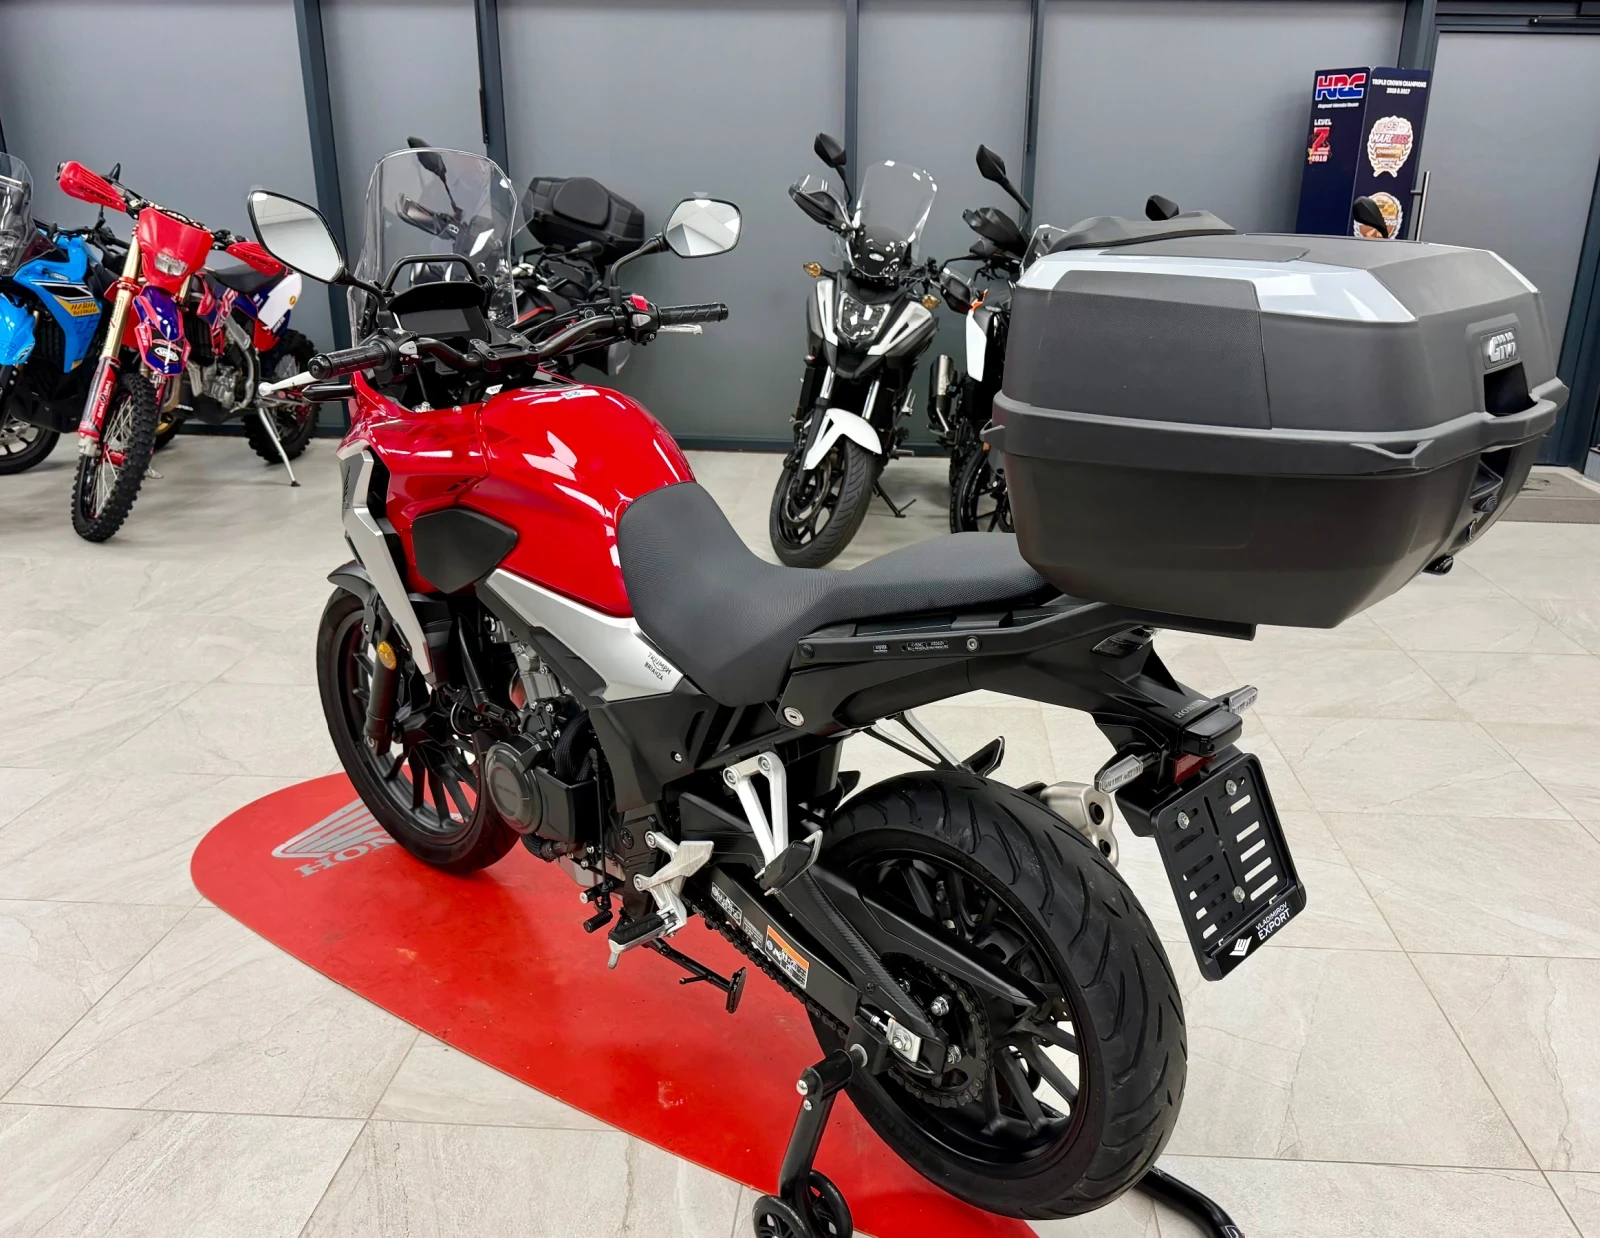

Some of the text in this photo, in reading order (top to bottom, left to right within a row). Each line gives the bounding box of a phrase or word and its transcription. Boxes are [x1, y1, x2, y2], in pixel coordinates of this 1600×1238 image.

[1315, 73, 1366, 100] HRC
[644, 661, 664, 681] BRIANZA
[647, 652, 672, 675] TRIUMPH
[1255, 901, 1288, 930] VLADIMIROV
[1257, 908, 1291, 940] EXPORT
